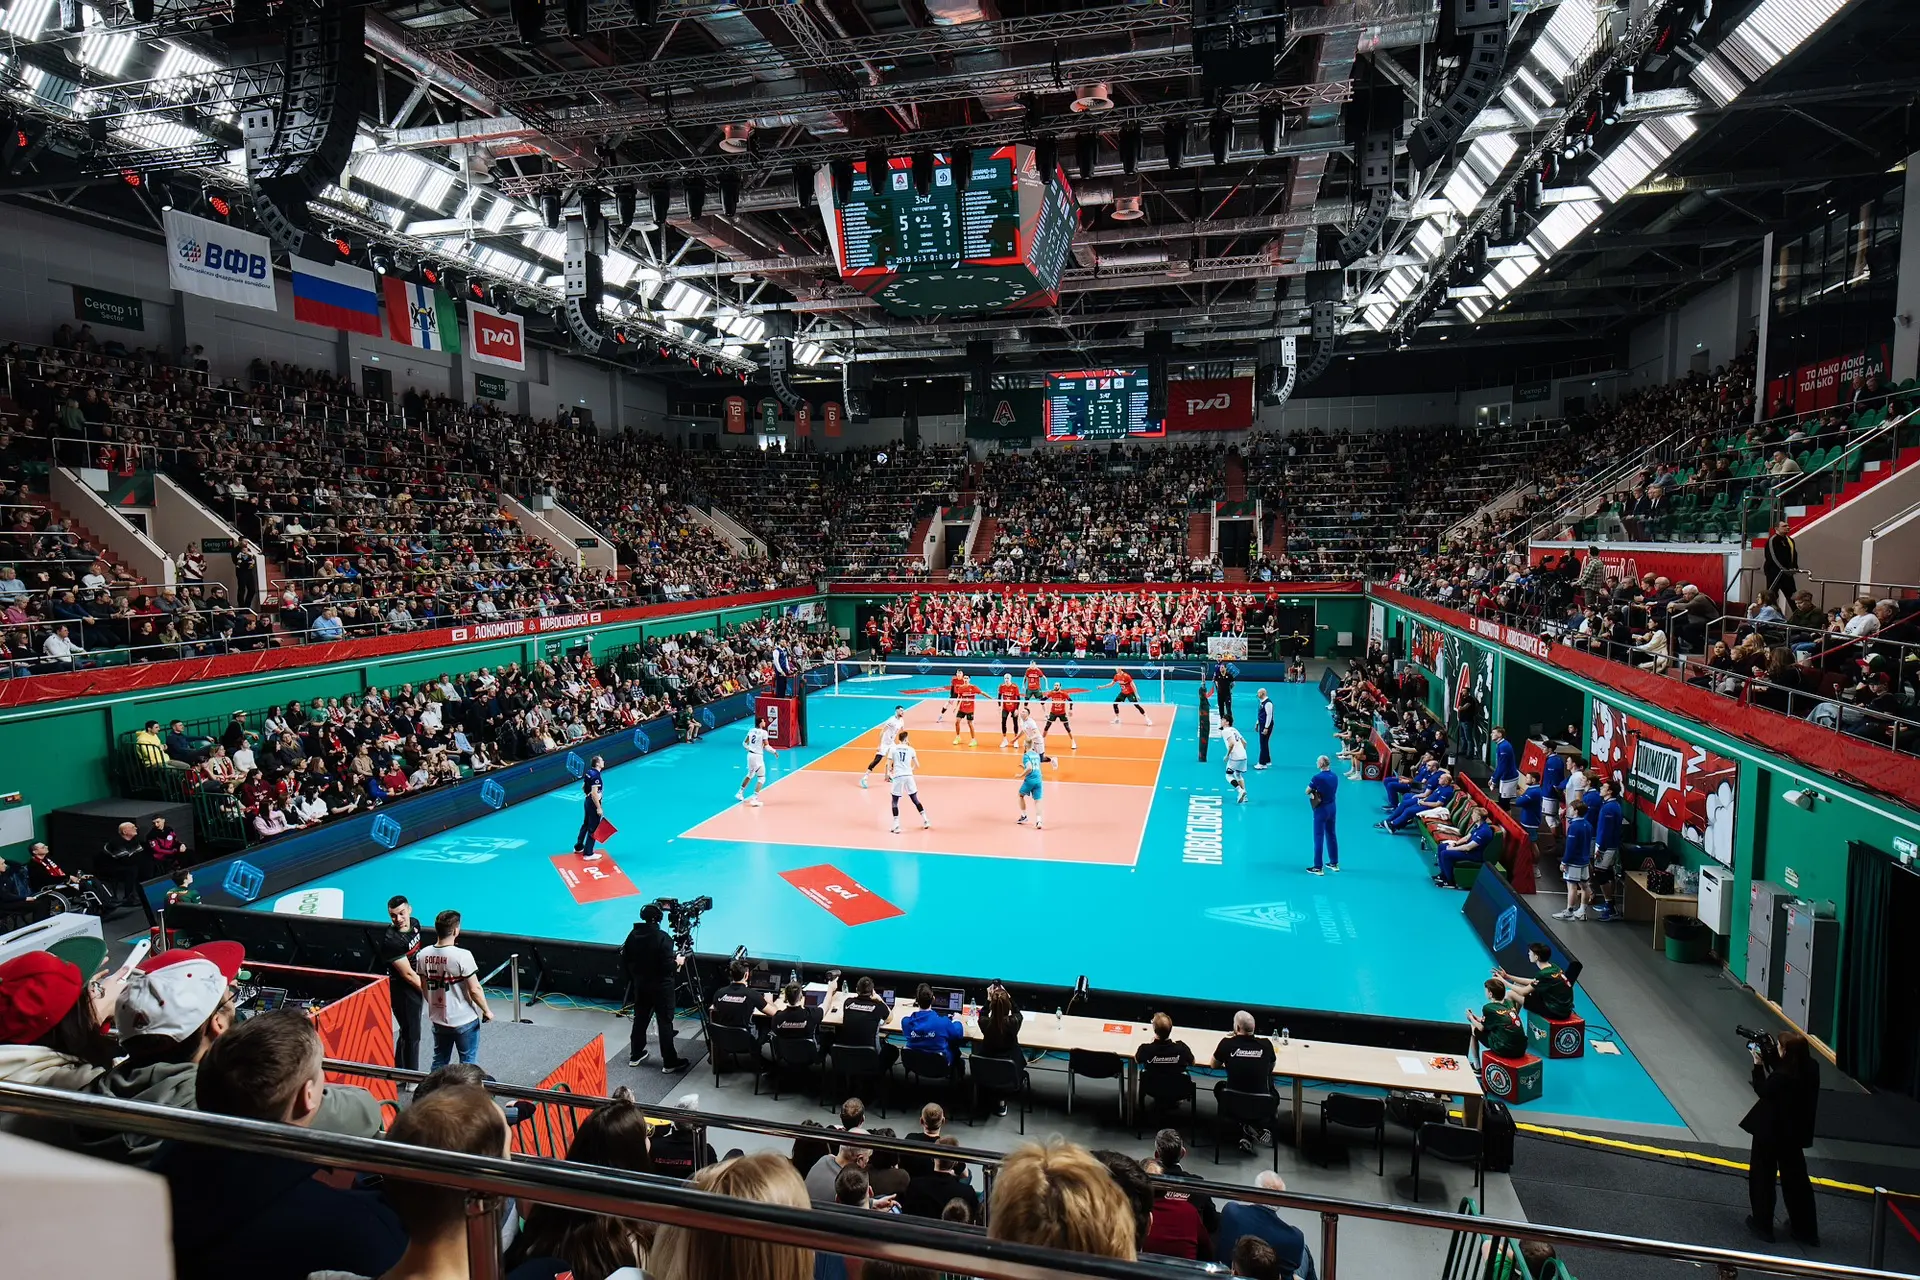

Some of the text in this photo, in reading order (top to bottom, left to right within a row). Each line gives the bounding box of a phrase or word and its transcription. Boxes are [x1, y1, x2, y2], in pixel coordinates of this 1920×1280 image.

[899, 215, 909, 231] 5
[942, 212, 952, 228] 3
[204, 242, 266, 279] ВФВ
[84, 297, 139, 317] Сектор 11
[100, 311, 124, 322] Sector
[1806, 362, 1839, 380] ТОЛЬКО
[1800, 375, 1833, 393] ТОЛЬКО
[730, 406, 742, 416] 12
[800, 410, 806, 420] 8
[1088, 404, 1094, 414] 5
[1116, 404, 1122, 413] 3
[828, 411, 836, 420] 6
[475, 621, 525, 639] ЛОКОМОТИВ
[540, 614, 588, 630] НОВОСИБИРСК
[751, 734, 757, 744] 2
[1182, 794, 1222, 865] НОВОСИБИРСК
[424, 956, 448, 964] БОГДАН
